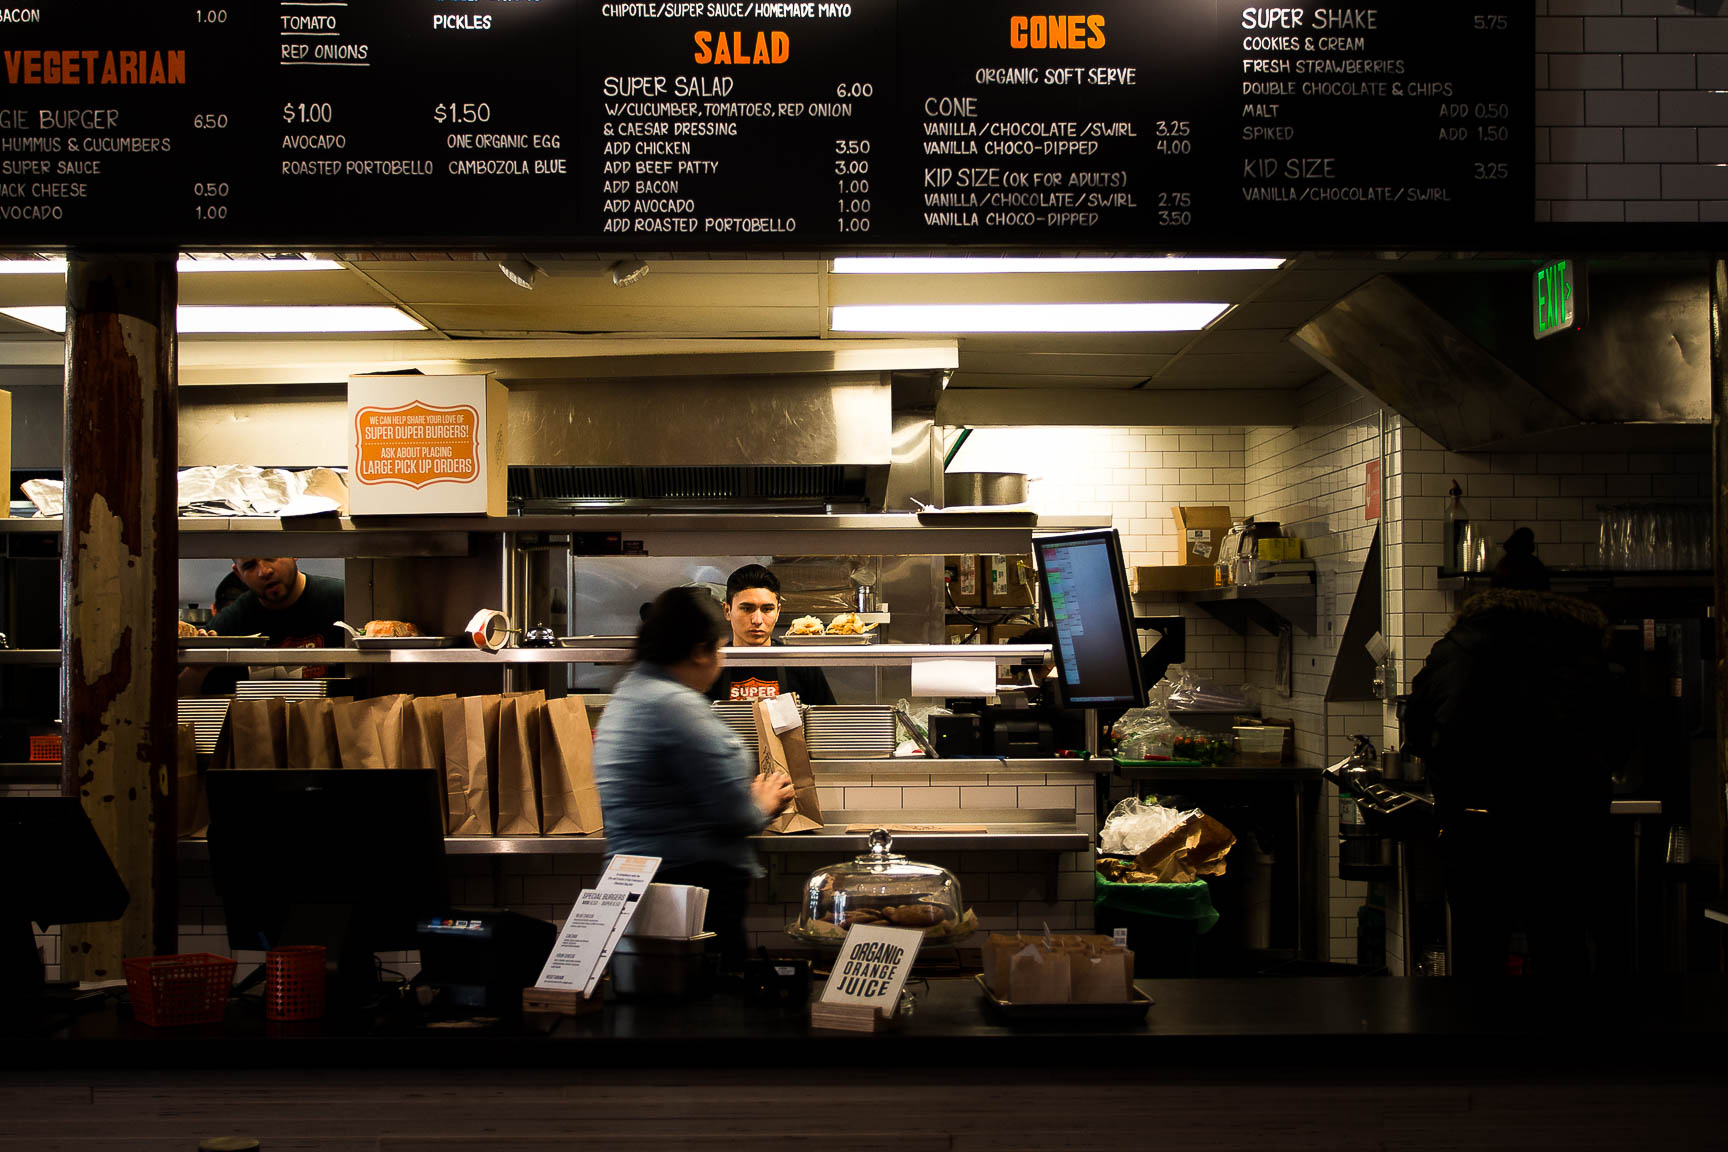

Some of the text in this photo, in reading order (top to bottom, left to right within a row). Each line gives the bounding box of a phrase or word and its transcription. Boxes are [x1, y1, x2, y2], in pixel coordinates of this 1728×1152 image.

[196, 9, 228, 24] 1.00
[601, 2, 705, 18] CHIPOTLE/SUPER
[817, 2, 852, 18] MAYO
[1241, 6, 1377, 30] SUPER SHAKE
[280, 15, 337, 30] TOMATO
[433, 14, 493, 30] PICKLES
[1473, 14, 1508, 30] 5.75
[1010, 14, 1106, 49] CONES
[281, 44, 369, 60] RED ONIONS
[694, 30, 790, 65] SALAD
[1242, 36, 1365, 52] COOKIES & CREAM
[3, 50, 186, 85] VEGETARIAN
[1242, 59, 1405, 74] FRESH STRAWBERRIES
[975, 67, 1137, 86] ORGANIC SOFT SERVE
[603, 76, 734, 97] SUPER SALAD
[836, 82, 873, 98] 6.00
[1242, 81, 1453, 97] DOUBLE CHOCOLATE & CHIPS
[282, 102, 332, 124] $1.00
[433, 102, 491, 124] $1.50
[778, 102, 805, 117] RED
[808, 103, 852, 117] ONION
[924, 96, 978, 118] CONE
[1242, 103, 1280, 118] MALT
[1439, 102, 1509, 119] ADD 0.50
[39, 108, 119, 130] BURGER
[193, 113, 228, 129] 6.50
[603, 121, 738, 136] & CAESAR DRESSING
[1155, 120, 1191, 137] 3.25
[1242, 126, 1295, 141] SPIKED
[1438, 125, 1509, 142] ADD 1.50
[1, 136, 171, 153] HUMMUS & CUCUMBERS
[281, 134, 346, 150] AVOCADO
[447, 133, 561, 149] ONE ORGANIC EGG
[603, 141, 691, 155] ADD CHICKEN
[835, 139, 871, 155] 3.50
[923, 140, 1099, 156] VANILLA CHOCO-DIPPED
[1156, 139, 1192, 155] 4.00
[2, 160, 101, 175] SUPER SAUCE
[282, 159, 433, 176] ROASTED PORTOBELLO
[448, 159, 567, 175] CAMBOZOLA BLUE
[603, 160, 719, 175] ADD BEEF PATTY
[834, 160, 869, 176] 3.00
[1243, 157, 1336, 179] KID SIZE
[1473, 162, 1509, 180] 3.25
[924, 167, 1127, 188] KID SIZE (OK FOR ADULTS)
[31, 182, 88, 198] CHEESE
[193, 182, 230, 197] 0.50
[603, 180, 679, 194] ADD BACON
[838, 179, 869, 194] 1.00
[603, 199, 695, 213] ADD AVOCADO
[838, 198, 871, 213] 1.00
[1158, 192, 1191, 207] 2.75
[195, 205, 228, 220] 1.00
[923, 212, 1099, 226] VANILLA CHOCO-DIPPED
[1157, 210, 1192, 226] 3.50
[603, 217, 796, 233] ADD ROASTED PORTOBELLO
[837, 217, 870, 233] 1.00
[1537, 260, 1566, 333] EXIT
[369, 414, 465, 425] WE CAN HELP SHARE YOUR LOVE OF
[365, 424, 469, 440] SUPER DUPER BURGERS!
[380, 446, 453, 459] ASK ABOUT PLACING
[363, 458, 472, 475] LARGE PICK UP ORDERS
[730, 686, 776, 697] SUPER
[850, 942, 904, 965] ORGANIC
[843, 961, 897, 980] ORANGE
[836, 976, 890, 997] JUICE
